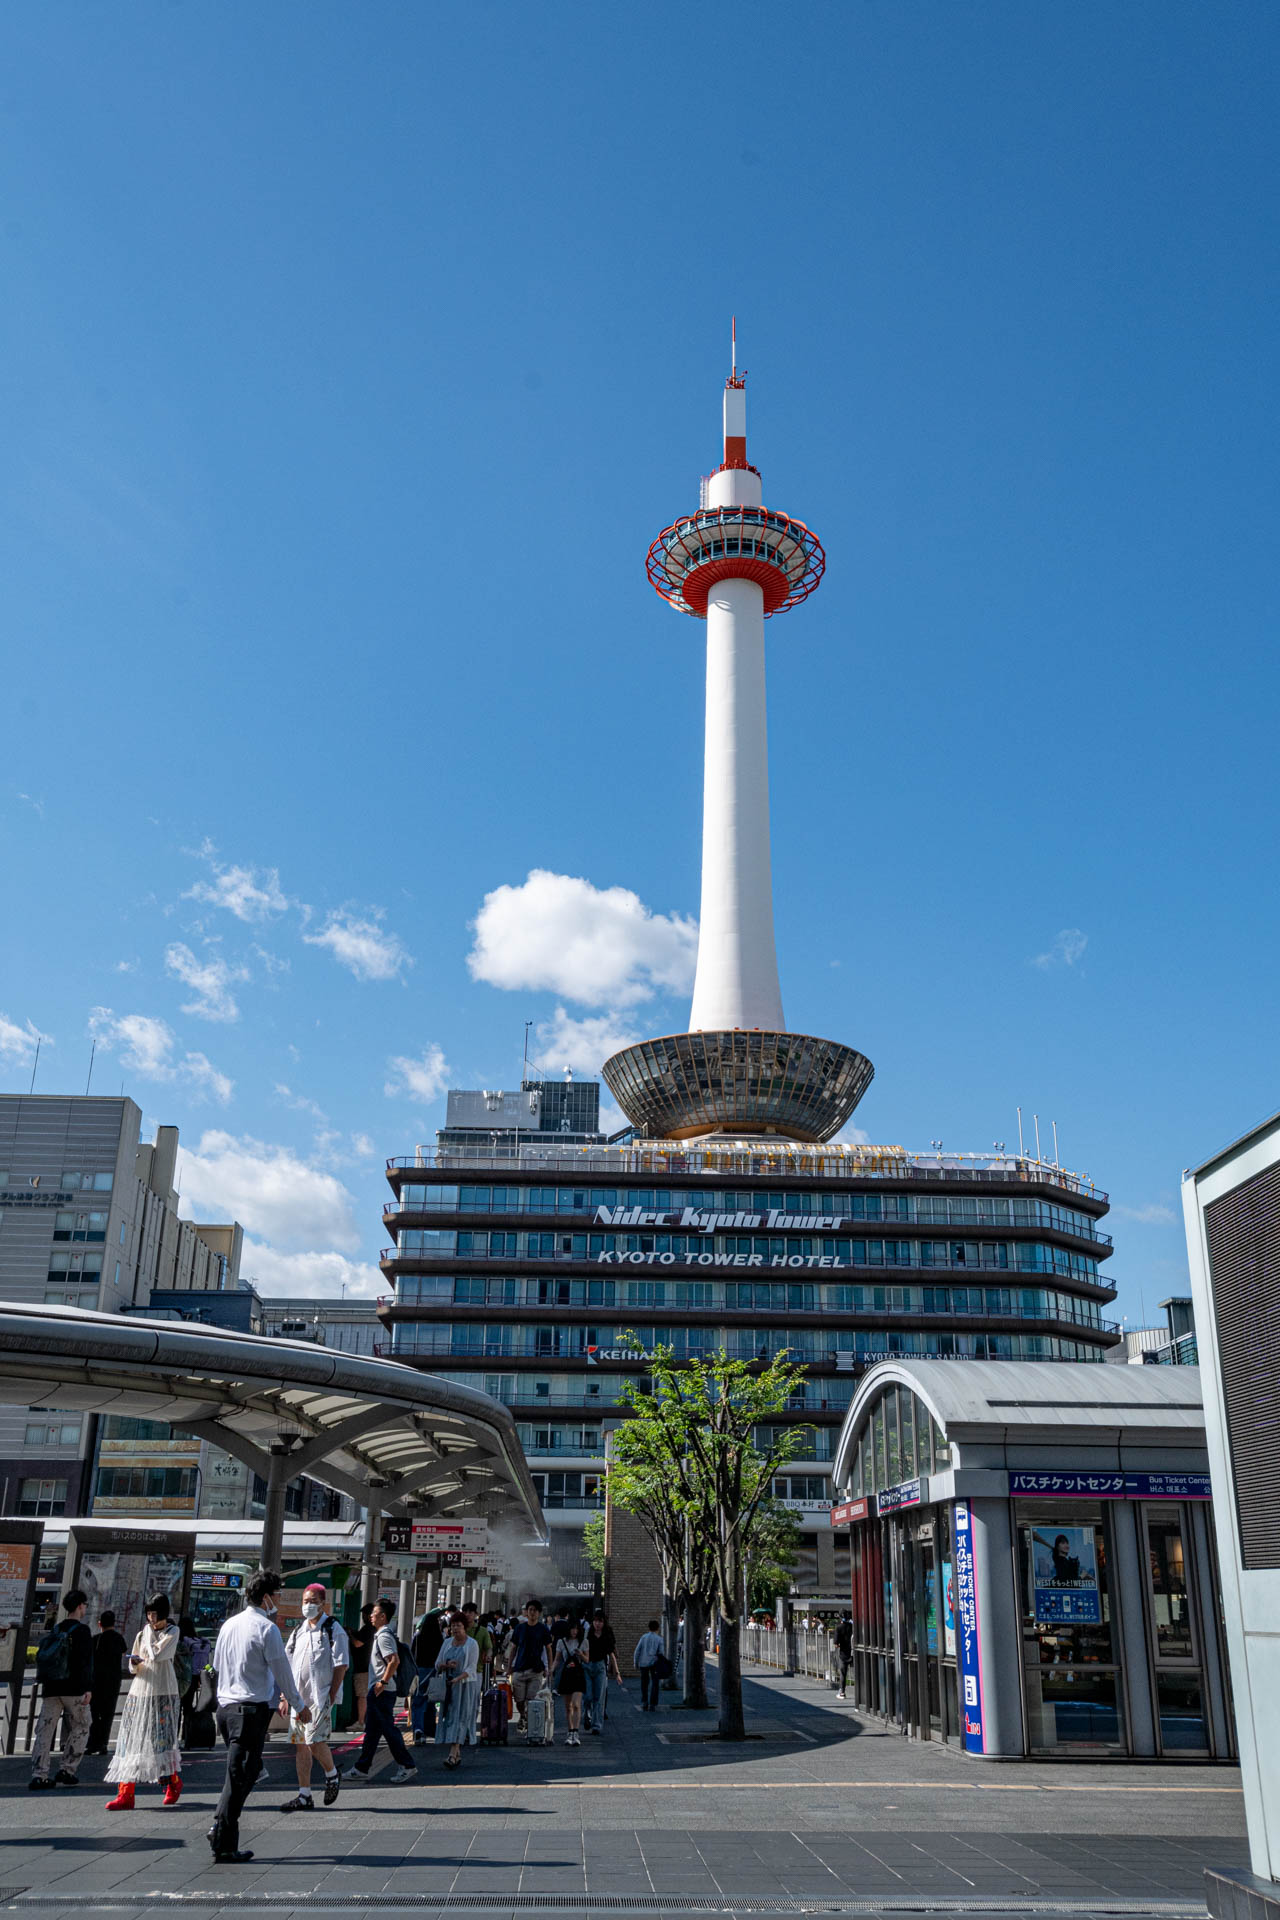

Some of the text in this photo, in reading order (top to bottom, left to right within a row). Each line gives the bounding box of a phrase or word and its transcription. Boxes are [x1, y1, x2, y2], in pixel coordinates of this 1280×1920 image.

[593, 1205, 848, 1233] Nidec Kyoto Tower
[597, 1250, 846, 1268] KYOTO TOWER HOTEL
[863, 1352, 969, 1362] KYOTO TOWER SANDO
[1013, 1476, 1138, 1491] バスチケットセンター
[1149, 1476, 1163, 1484] Bus
[1164, 1476, 1187, 1484] Ticket
[391, 1534, 406, 1544] D1
[967, 1572, 975, 1598] TICKET
[968, 1599, 976, 1631] CENTER
